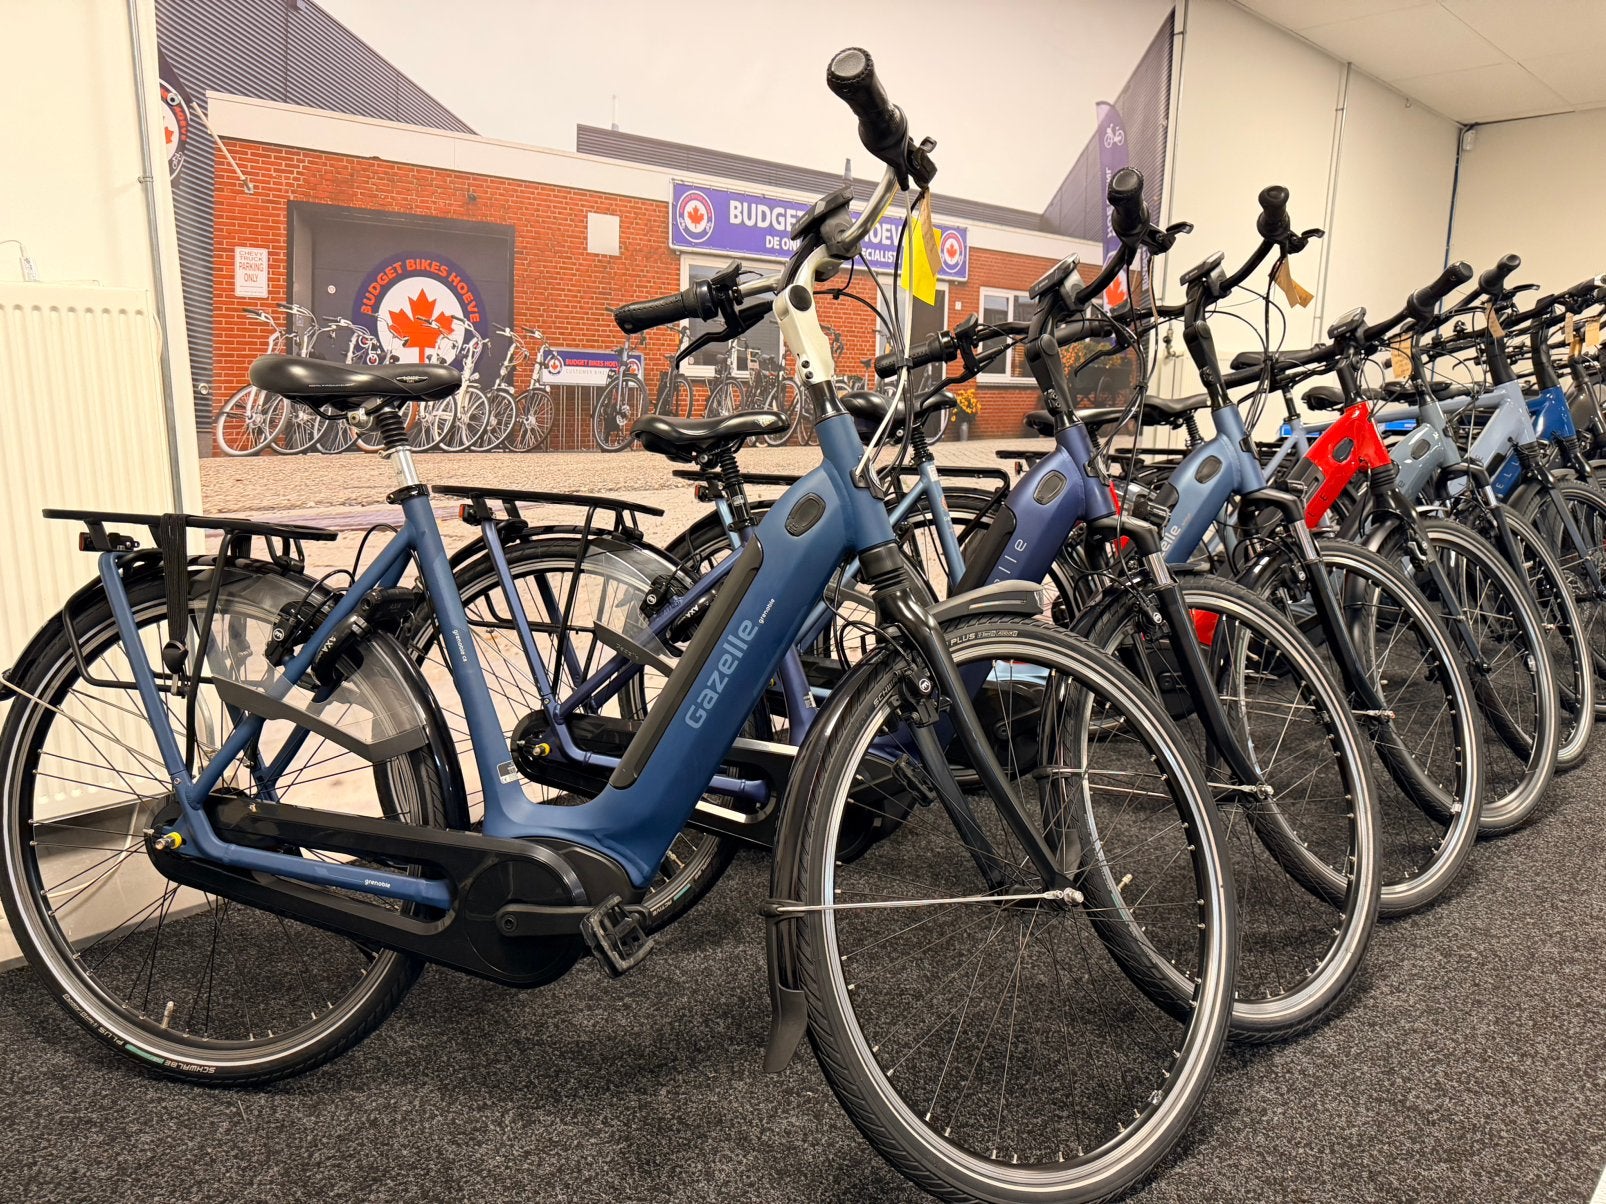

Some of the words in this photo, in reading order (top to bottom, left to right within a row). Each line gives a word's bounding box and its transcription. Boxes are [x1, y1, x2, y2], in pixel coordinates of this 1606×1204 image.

[729, 200, 806, 232] BUDGE
[766, 235, 780, 250] DE
[238, 261, 264, 272] PARKING
[243, 272, 259, 283] ONLY
[361, 262, 403, 315] BUDGET
[405, 259, 449, 277] BIKES
[448, 272, 480, 323] HOEVE
[565, 358, 588, 367] BUDGET
[685, 604, 699, 618] AXA
[758, 598, 776, 625] grenoble
[320, 635, 337, 653] AXA
[452, 629, 465, 655] grenoble
[950, 632, 976, 646] PLUS
[684, 619, 759, 729] Gazelle
[364, 879, 391, 888] grenoble
[97, 1026, 125, 1046] PLUS
[164, 1059, 217, 1074] SCHWALBE
